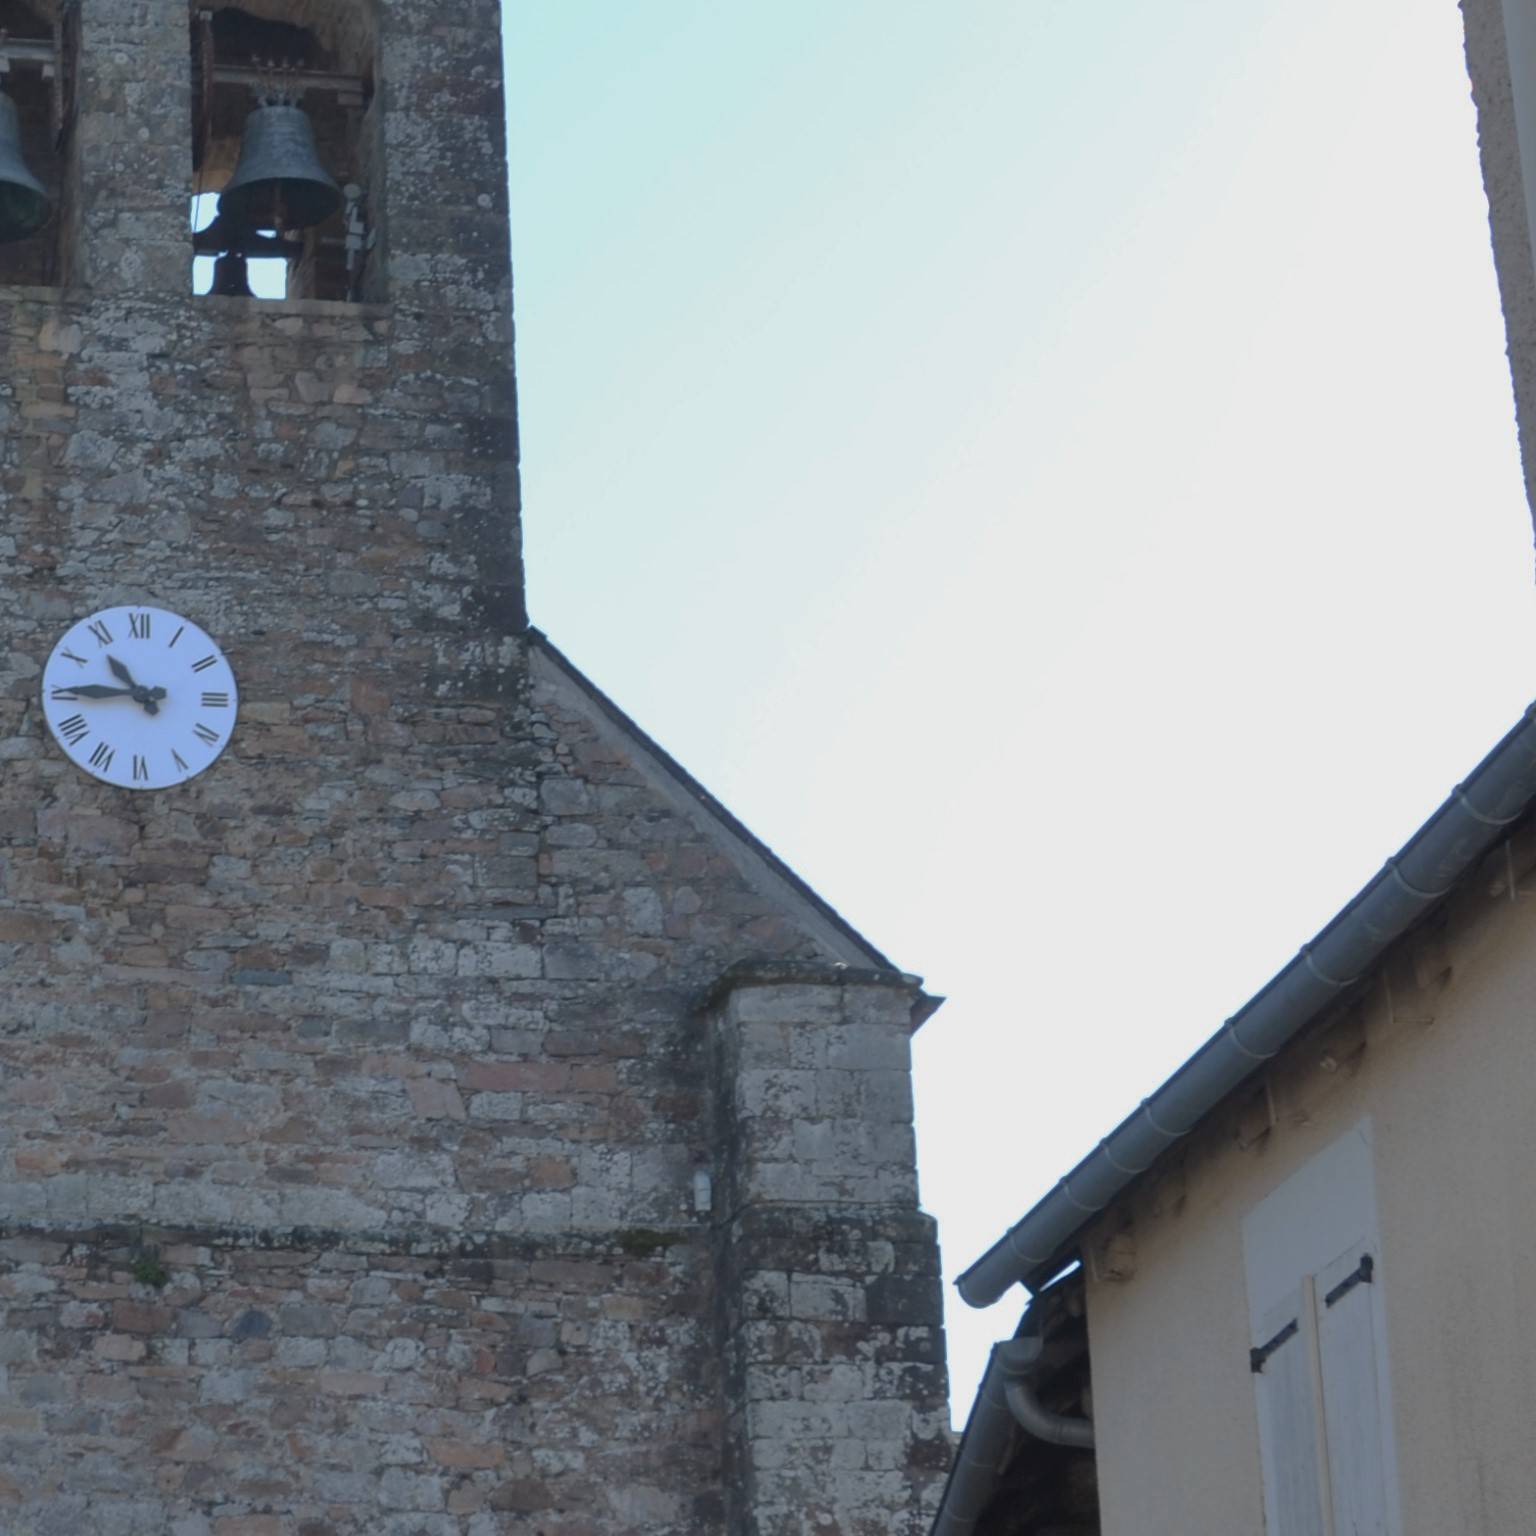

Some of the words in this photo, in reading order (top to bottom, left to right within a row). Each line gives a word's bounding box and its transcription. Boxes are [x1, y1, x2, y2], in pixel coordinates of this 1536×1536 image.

[88, 620, 114, 648] XI
[128, 613, 151, 640] XII
[167, 626, 185, 648] I
[60, 647, 89, 669] X
[191, 655, 218, 673] II
[201, 692, 229, 708] III
[57, 714, 91, 746] VIII
[193, 722, 221, 748] IV
[88, 741, 116, 773] VII
[133, 754, 149, 781] VI
[171, 747, 190, 773] V
